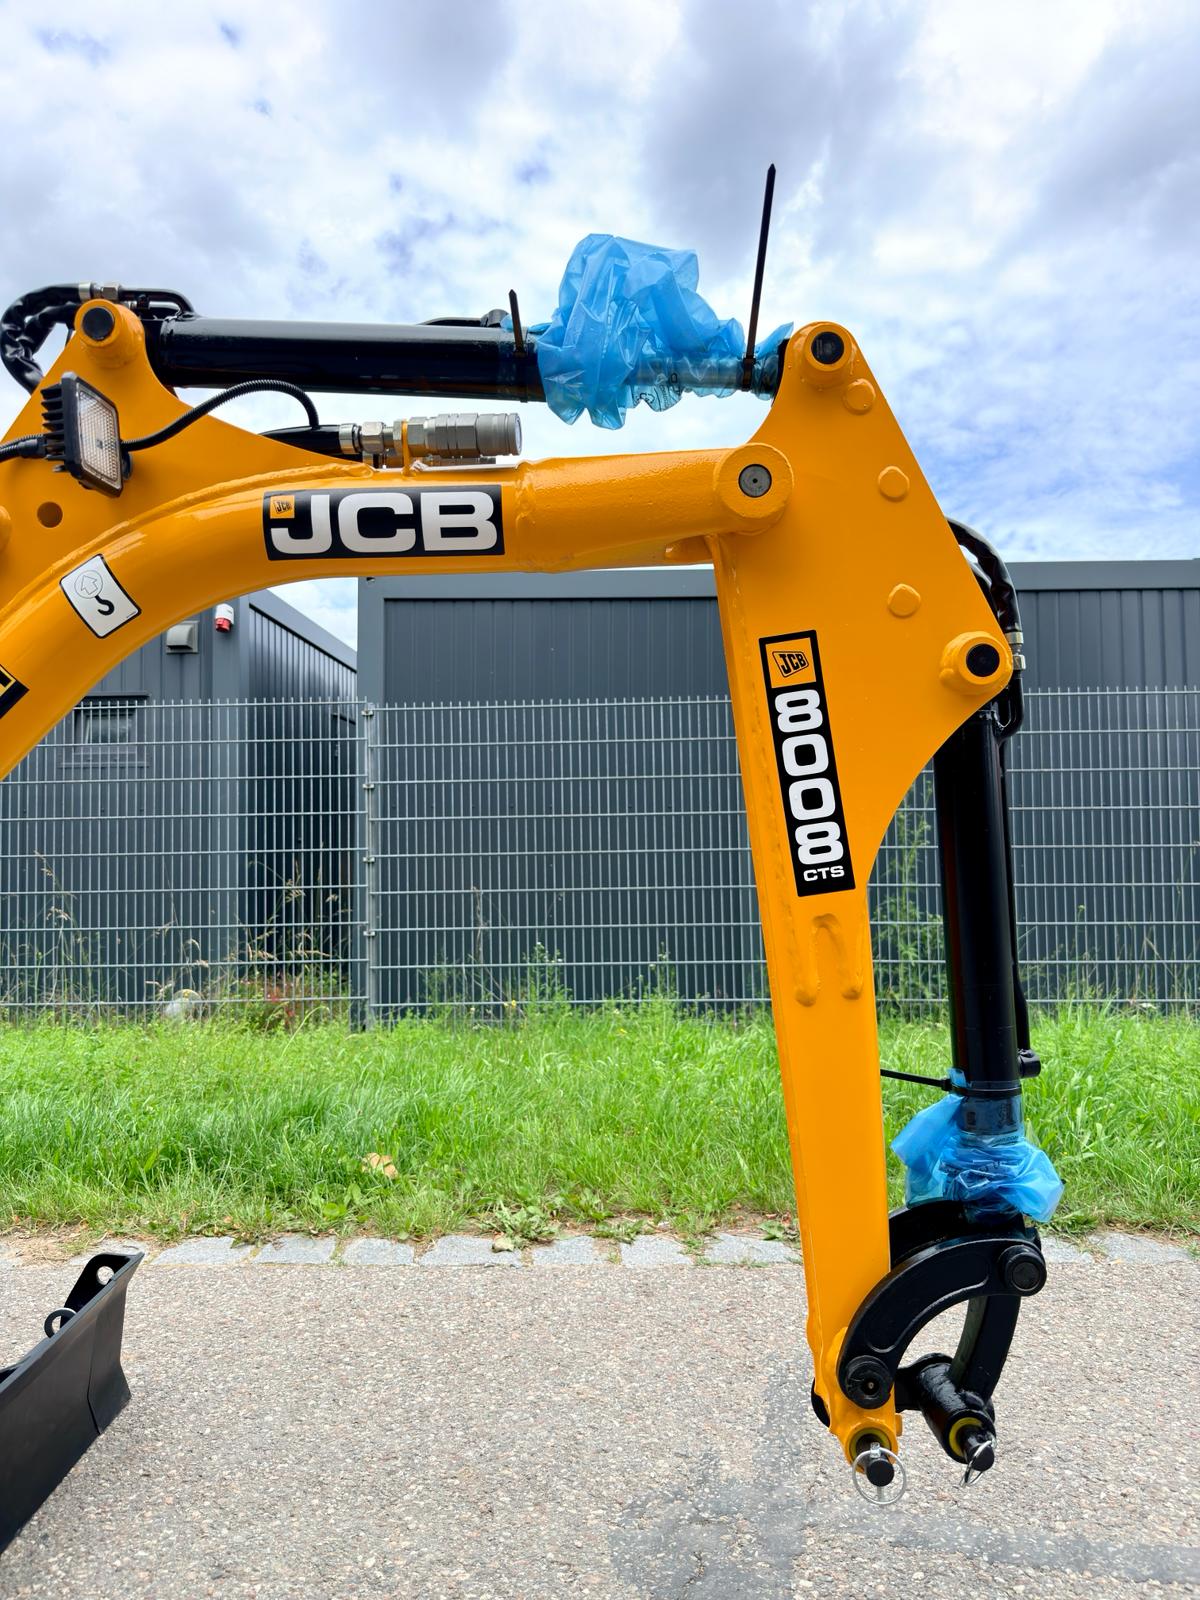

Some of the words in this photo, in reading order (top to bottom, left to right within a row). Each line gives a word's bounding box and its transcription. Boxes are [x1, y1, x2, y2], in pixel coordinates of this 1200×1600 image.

[271, 492, 498, 554] JCB
[779, 652, 807, 675] JCB
[774, 689, 844, 865] 8008
[803, 865, 845, 882] CTS
